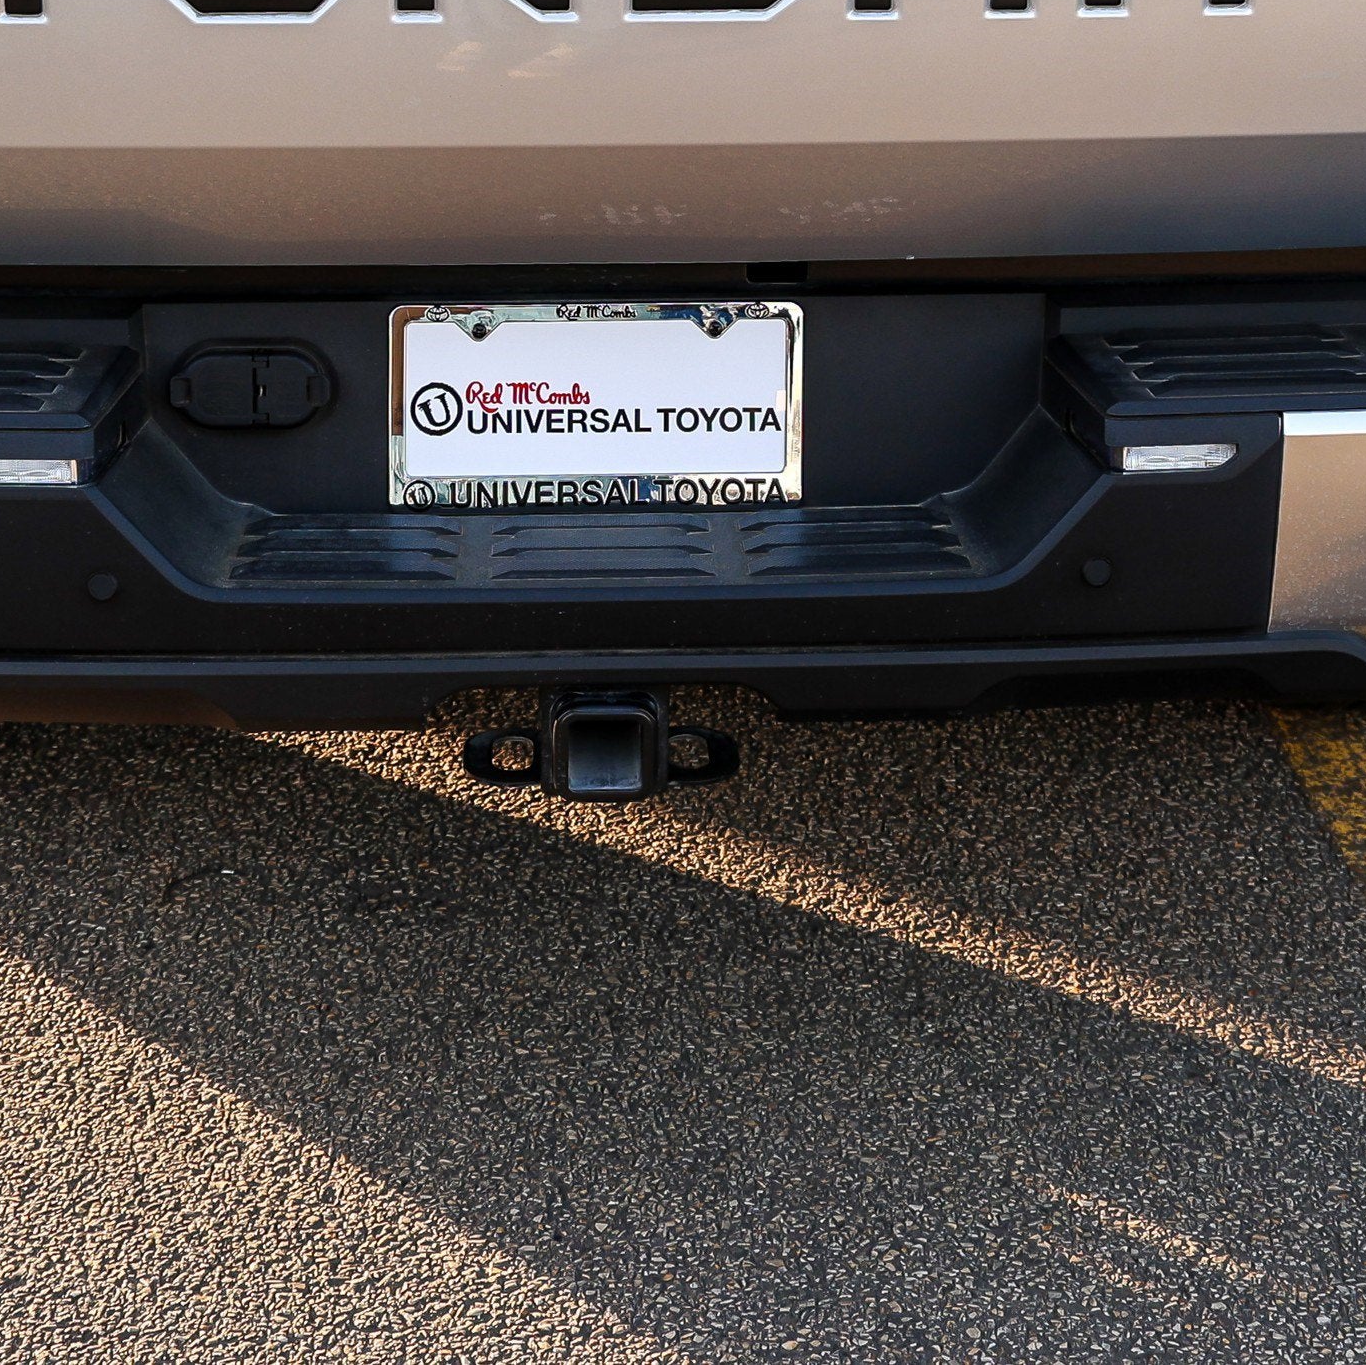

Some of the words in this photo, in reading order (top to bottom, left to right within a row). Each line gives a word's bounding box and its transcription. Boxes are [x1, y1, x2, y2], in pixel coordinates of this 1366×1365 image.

[556, 303, 581, 321] Red
[465, 381, 503, 414] Red
[506, 381, 591, 406] McCombs
[466, 407, 652, 435] UNIVERSAL
[656, 406, 782, 433] TOYOTA
[449, 479, 650, 508] UNIVERSAL
[653, 478, 790, 506] TOYOTA
